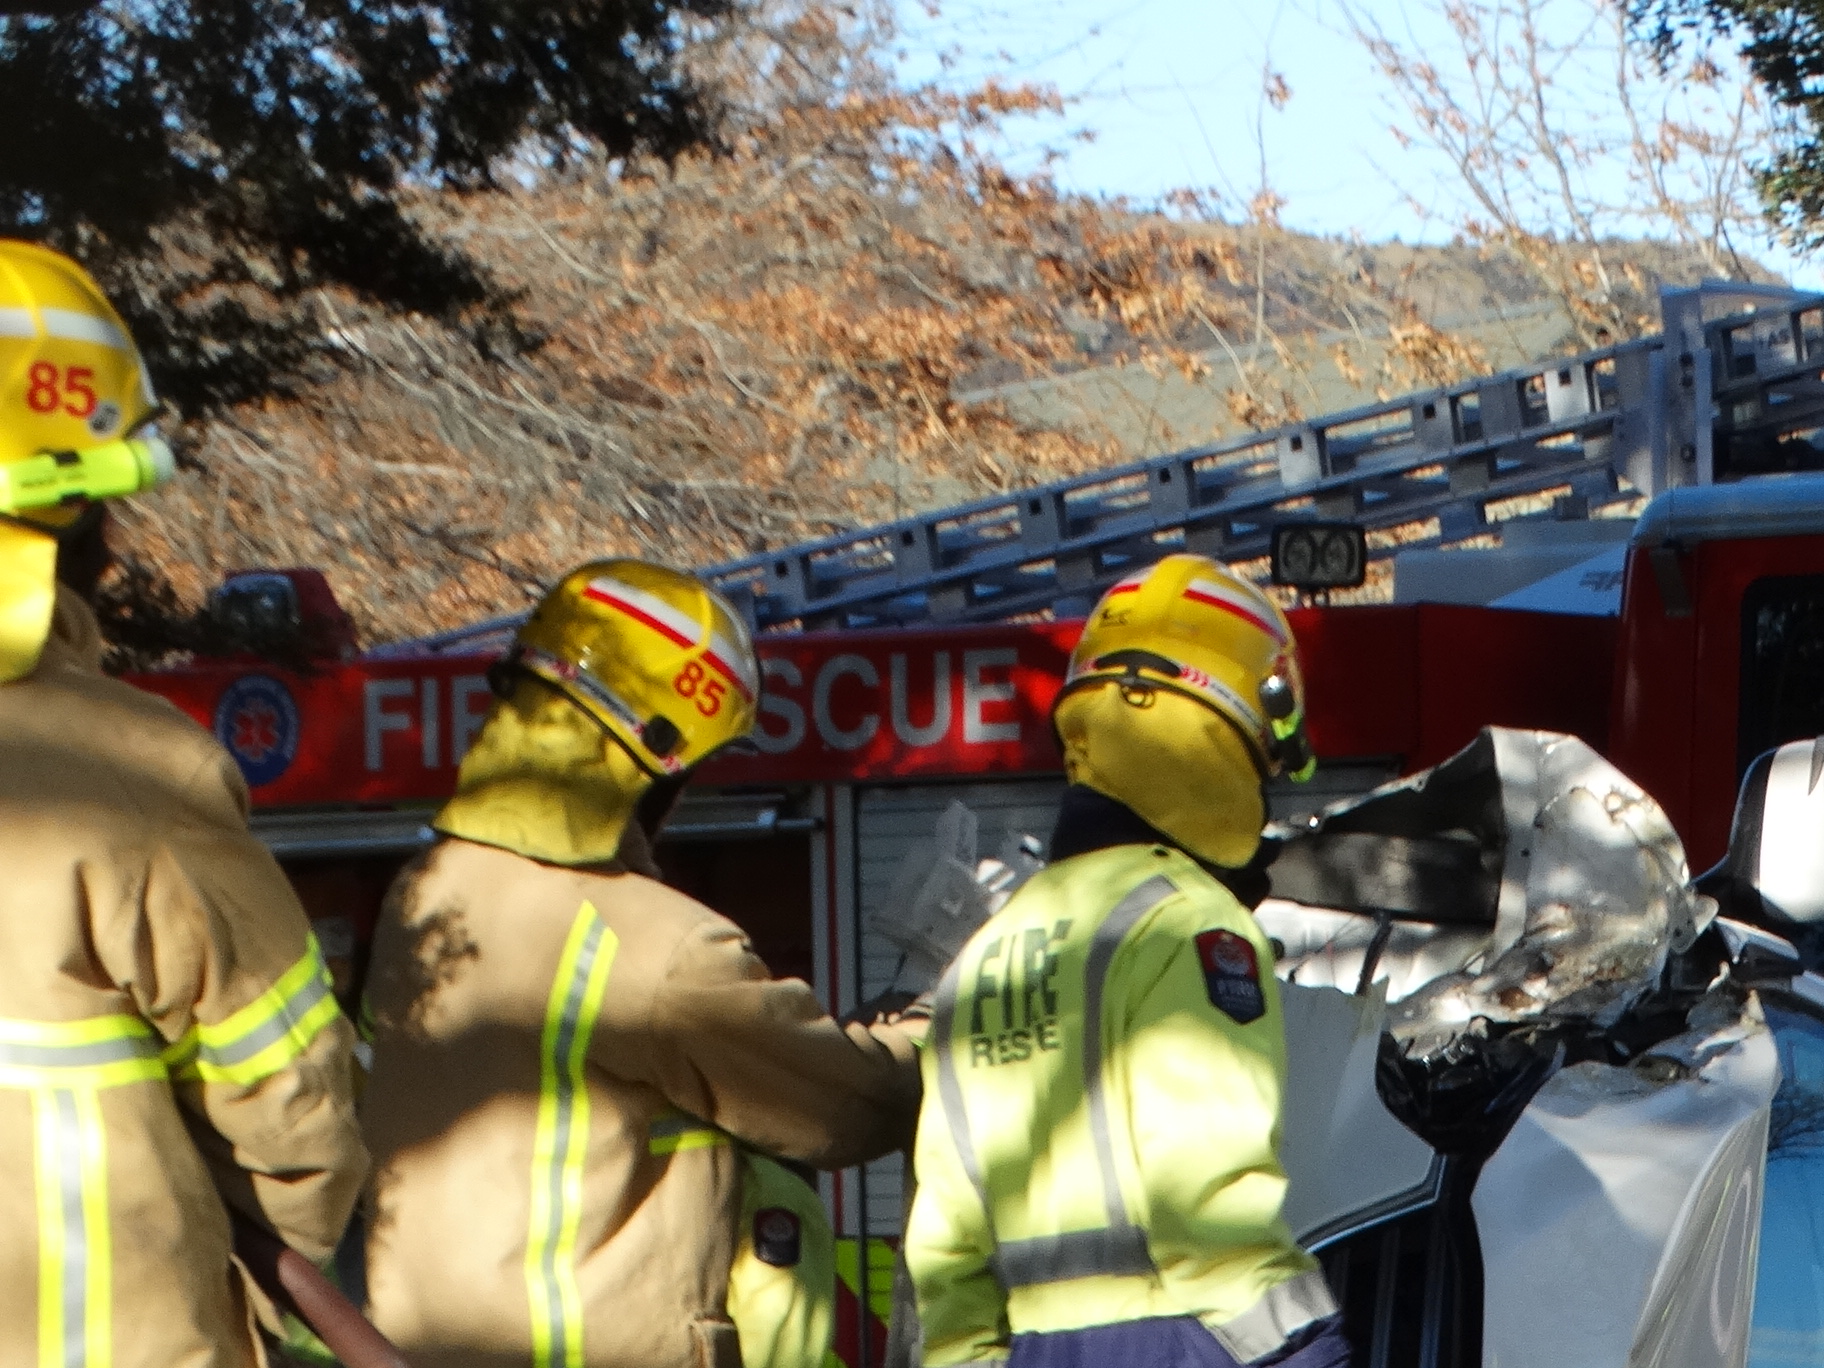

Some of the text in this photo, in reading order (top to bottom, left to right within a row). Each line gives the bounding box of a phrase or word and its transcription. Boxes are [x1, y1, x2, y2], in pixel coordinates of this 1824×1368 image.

[26, 360, 97, 420] 85
[674, 660, 726, 718] 85
[752, 648, 1021, 755] SCUE
